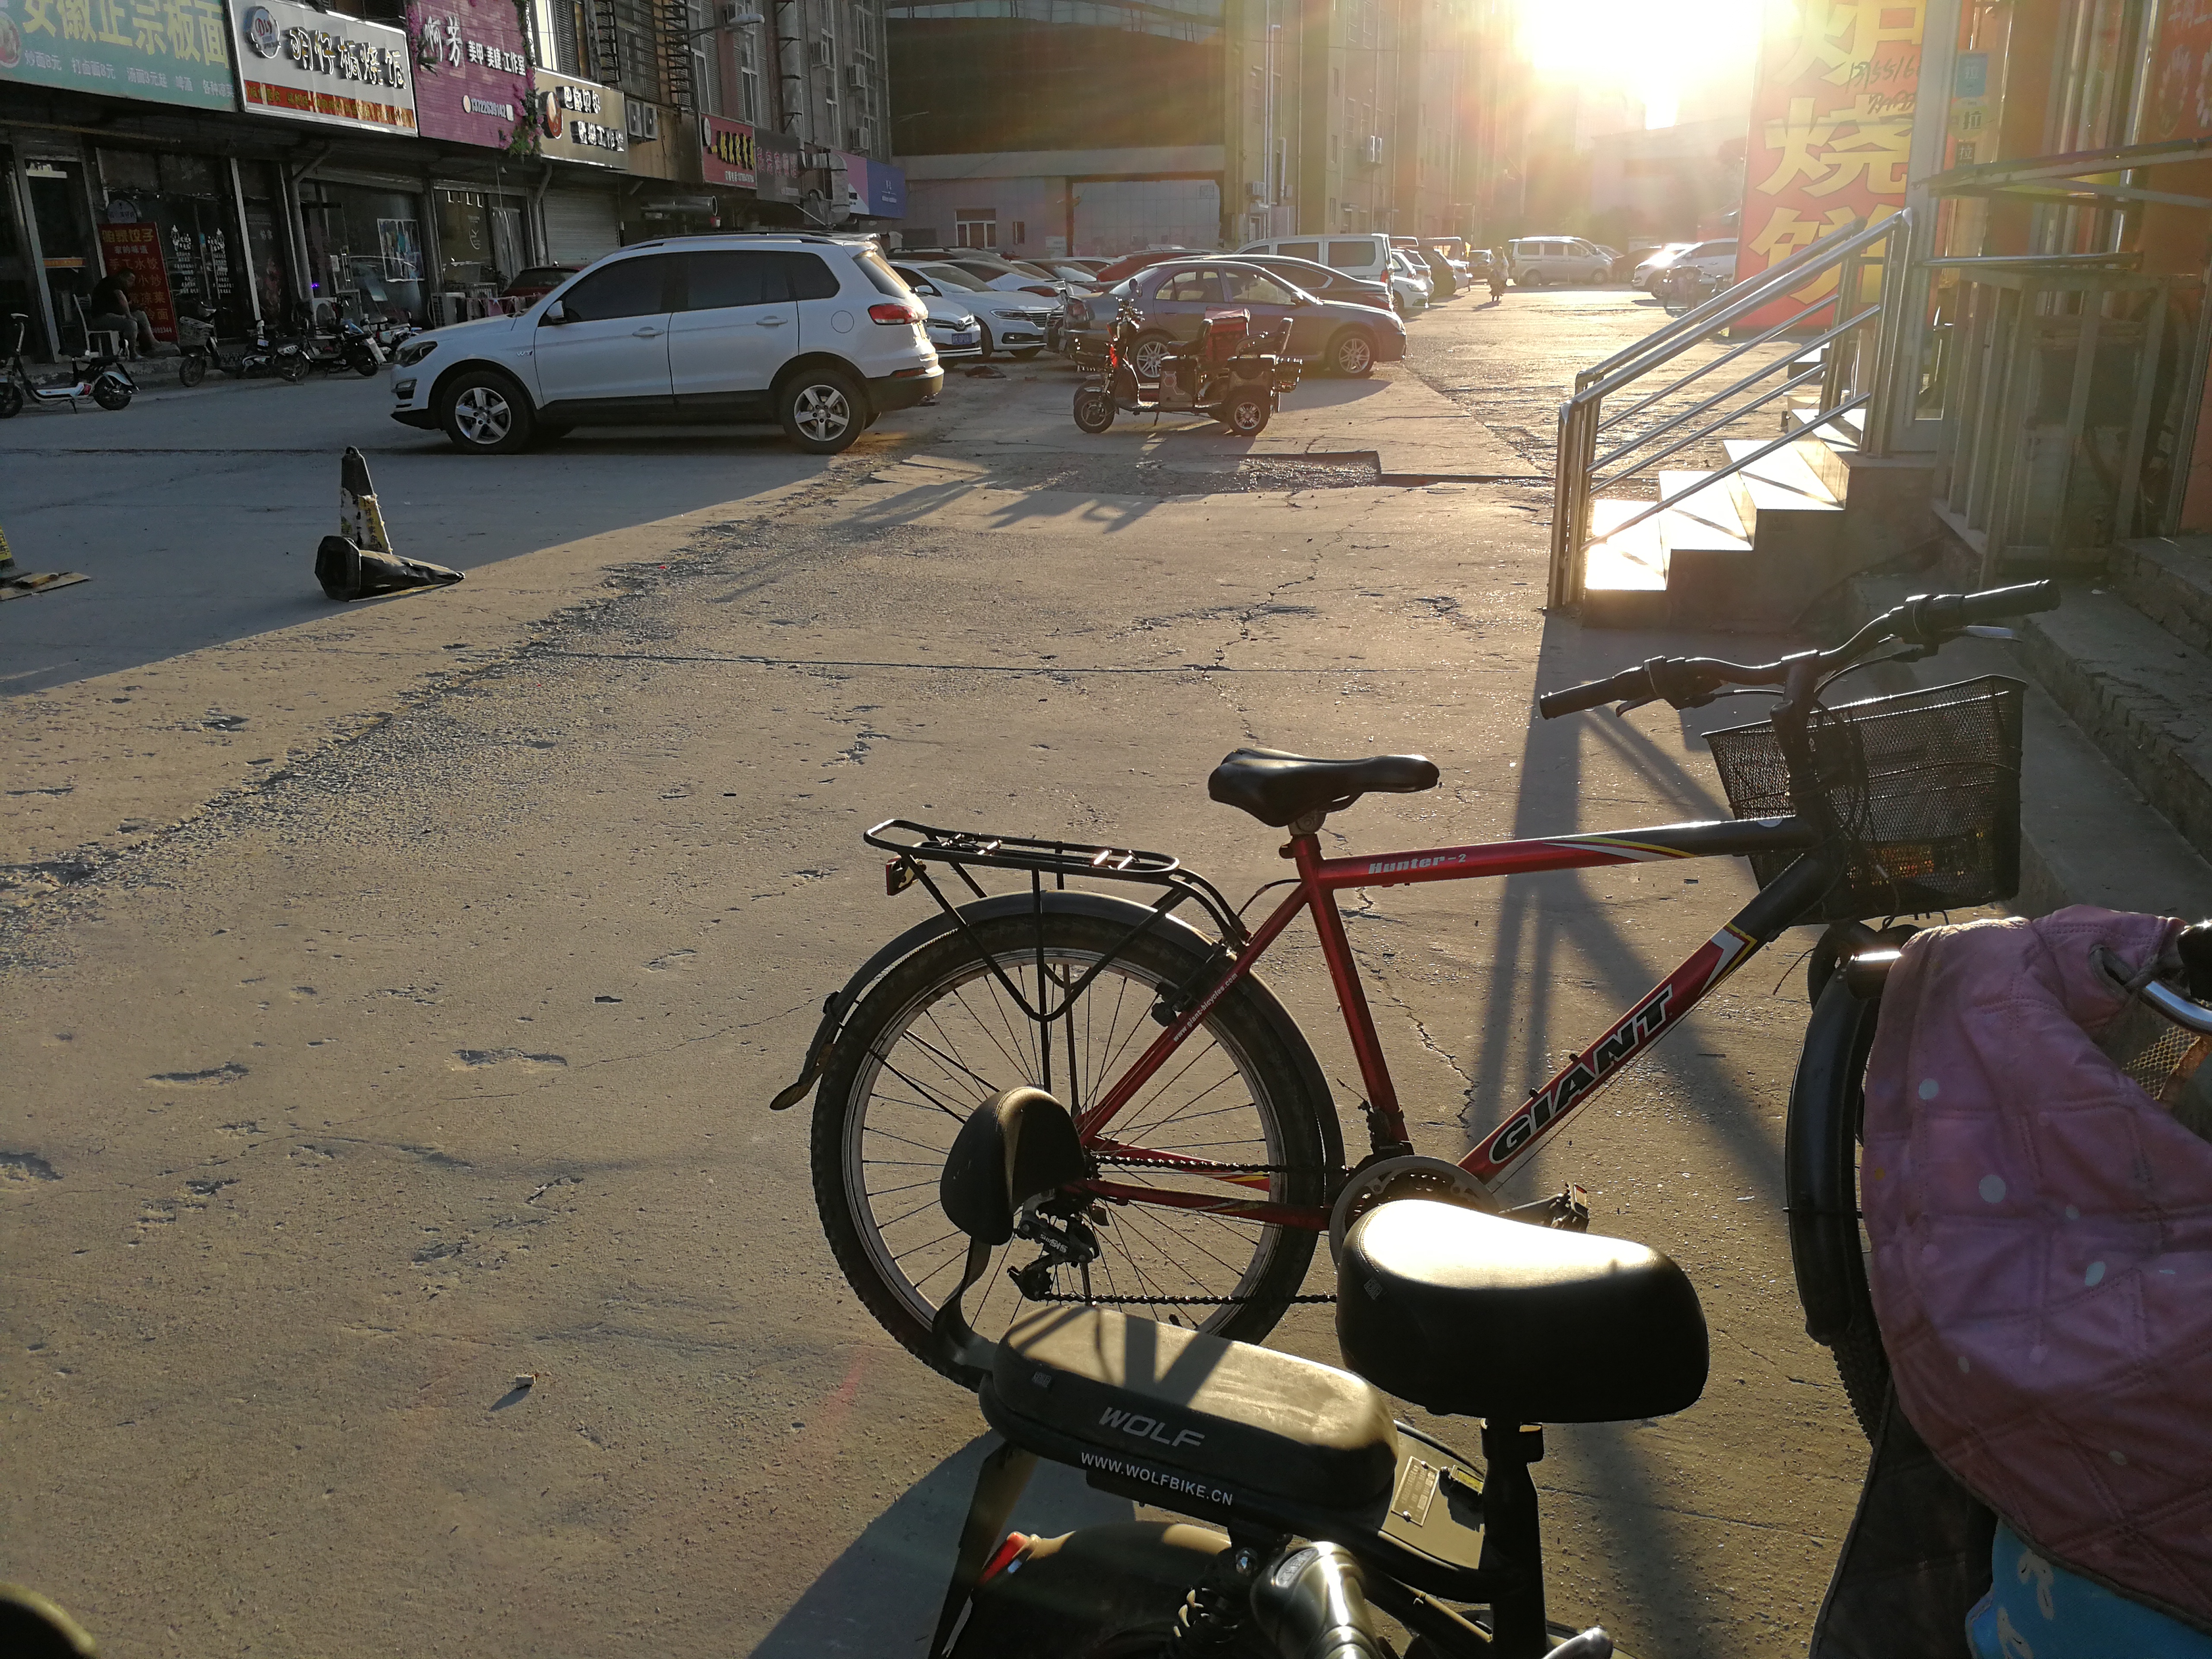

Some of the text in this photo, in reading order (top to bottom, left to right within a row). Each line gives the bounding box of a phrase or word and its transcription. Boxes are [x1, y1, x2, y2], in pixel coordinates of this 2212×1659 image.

[1962, 111, 1982, 130] 拉
[1959, 146, 1973, 160] 拉
[109, 257, 159, 270] 手工水饺
[1368, 854, 1466, 874] Hunter-2
[1489, 983, 1673, 1164] GIANT
[1099, 1407, 1205, 1447] WOLF
[1081, 1452, 1233, 1506] WWW.WOLFBIKE.CN
